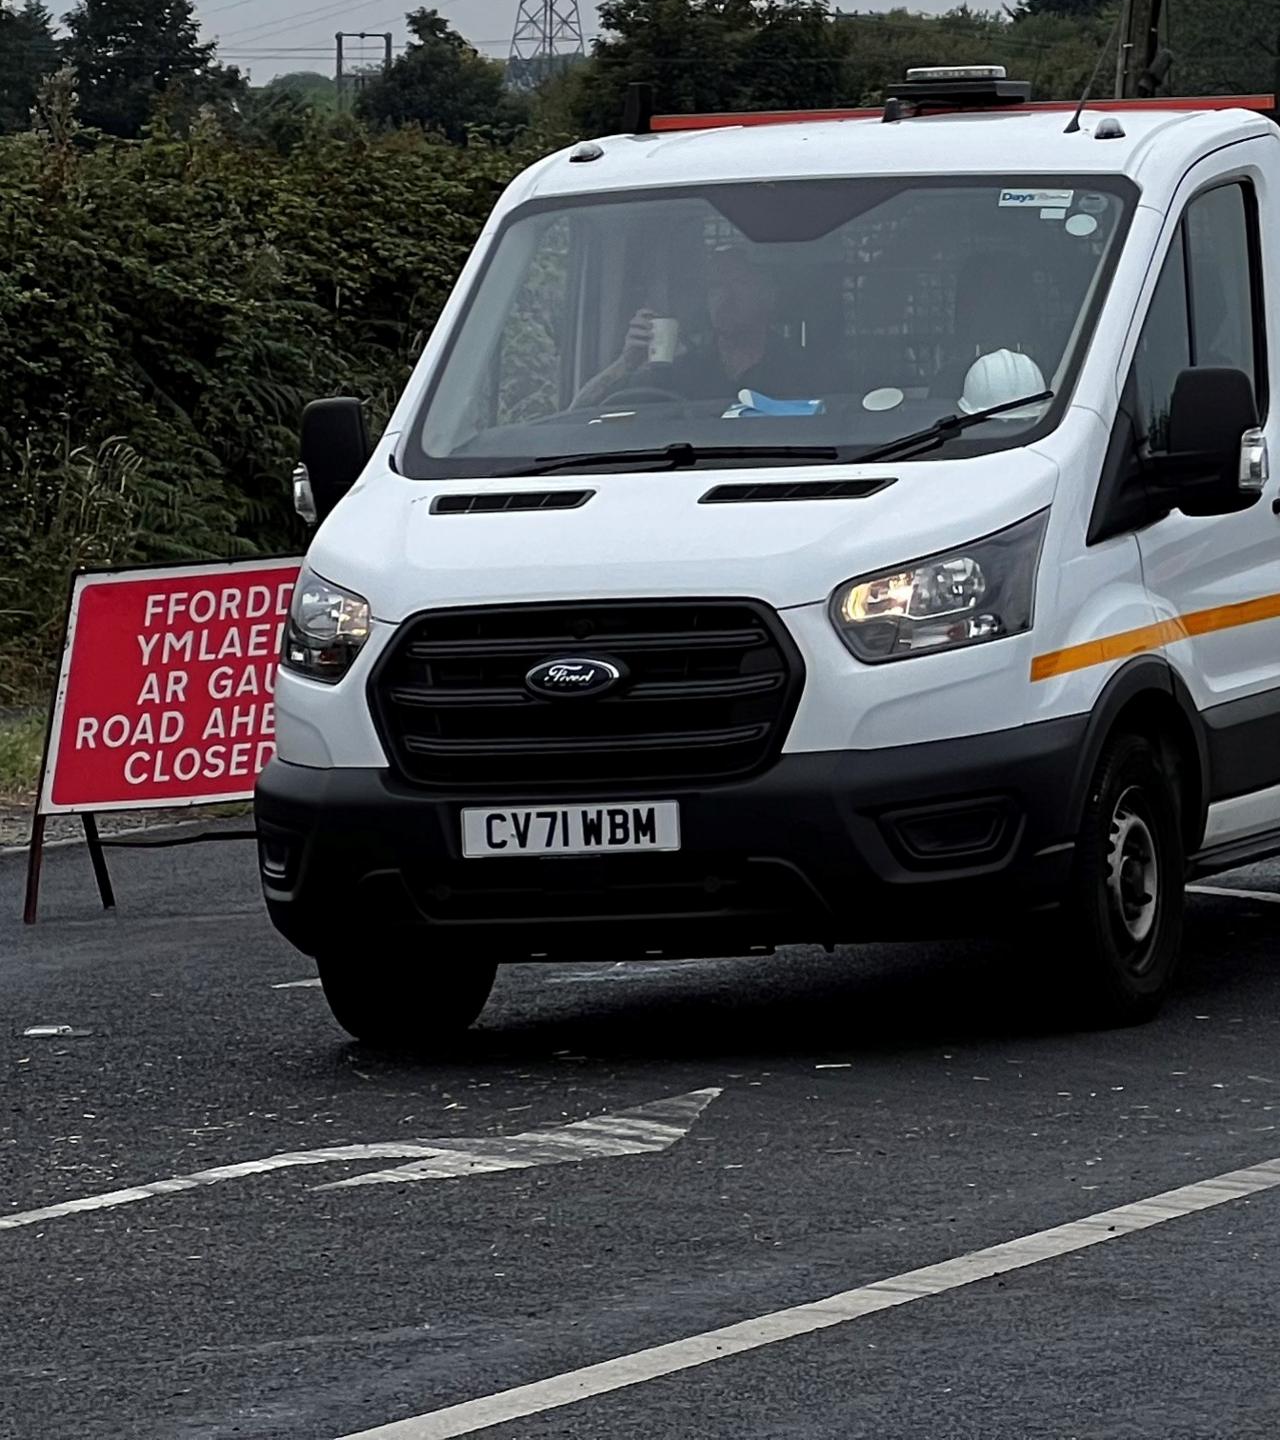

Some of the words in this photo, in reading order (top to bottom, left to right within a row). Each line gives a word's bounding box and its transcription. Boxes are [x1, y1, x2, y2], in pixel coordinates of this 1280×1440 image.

[144, 584, 294, 627] FFORDD
[137, 672, 187, 705] AR
[544, 665, 594, 682] Ford
[76, 711, 185, 750] ROAD
[202, 703, 275, 740] AHE
[124, 741, 277, 784] CLOSED
[485, 811, 569, 849] CV71
[581, 807, 656, 846] WBM
